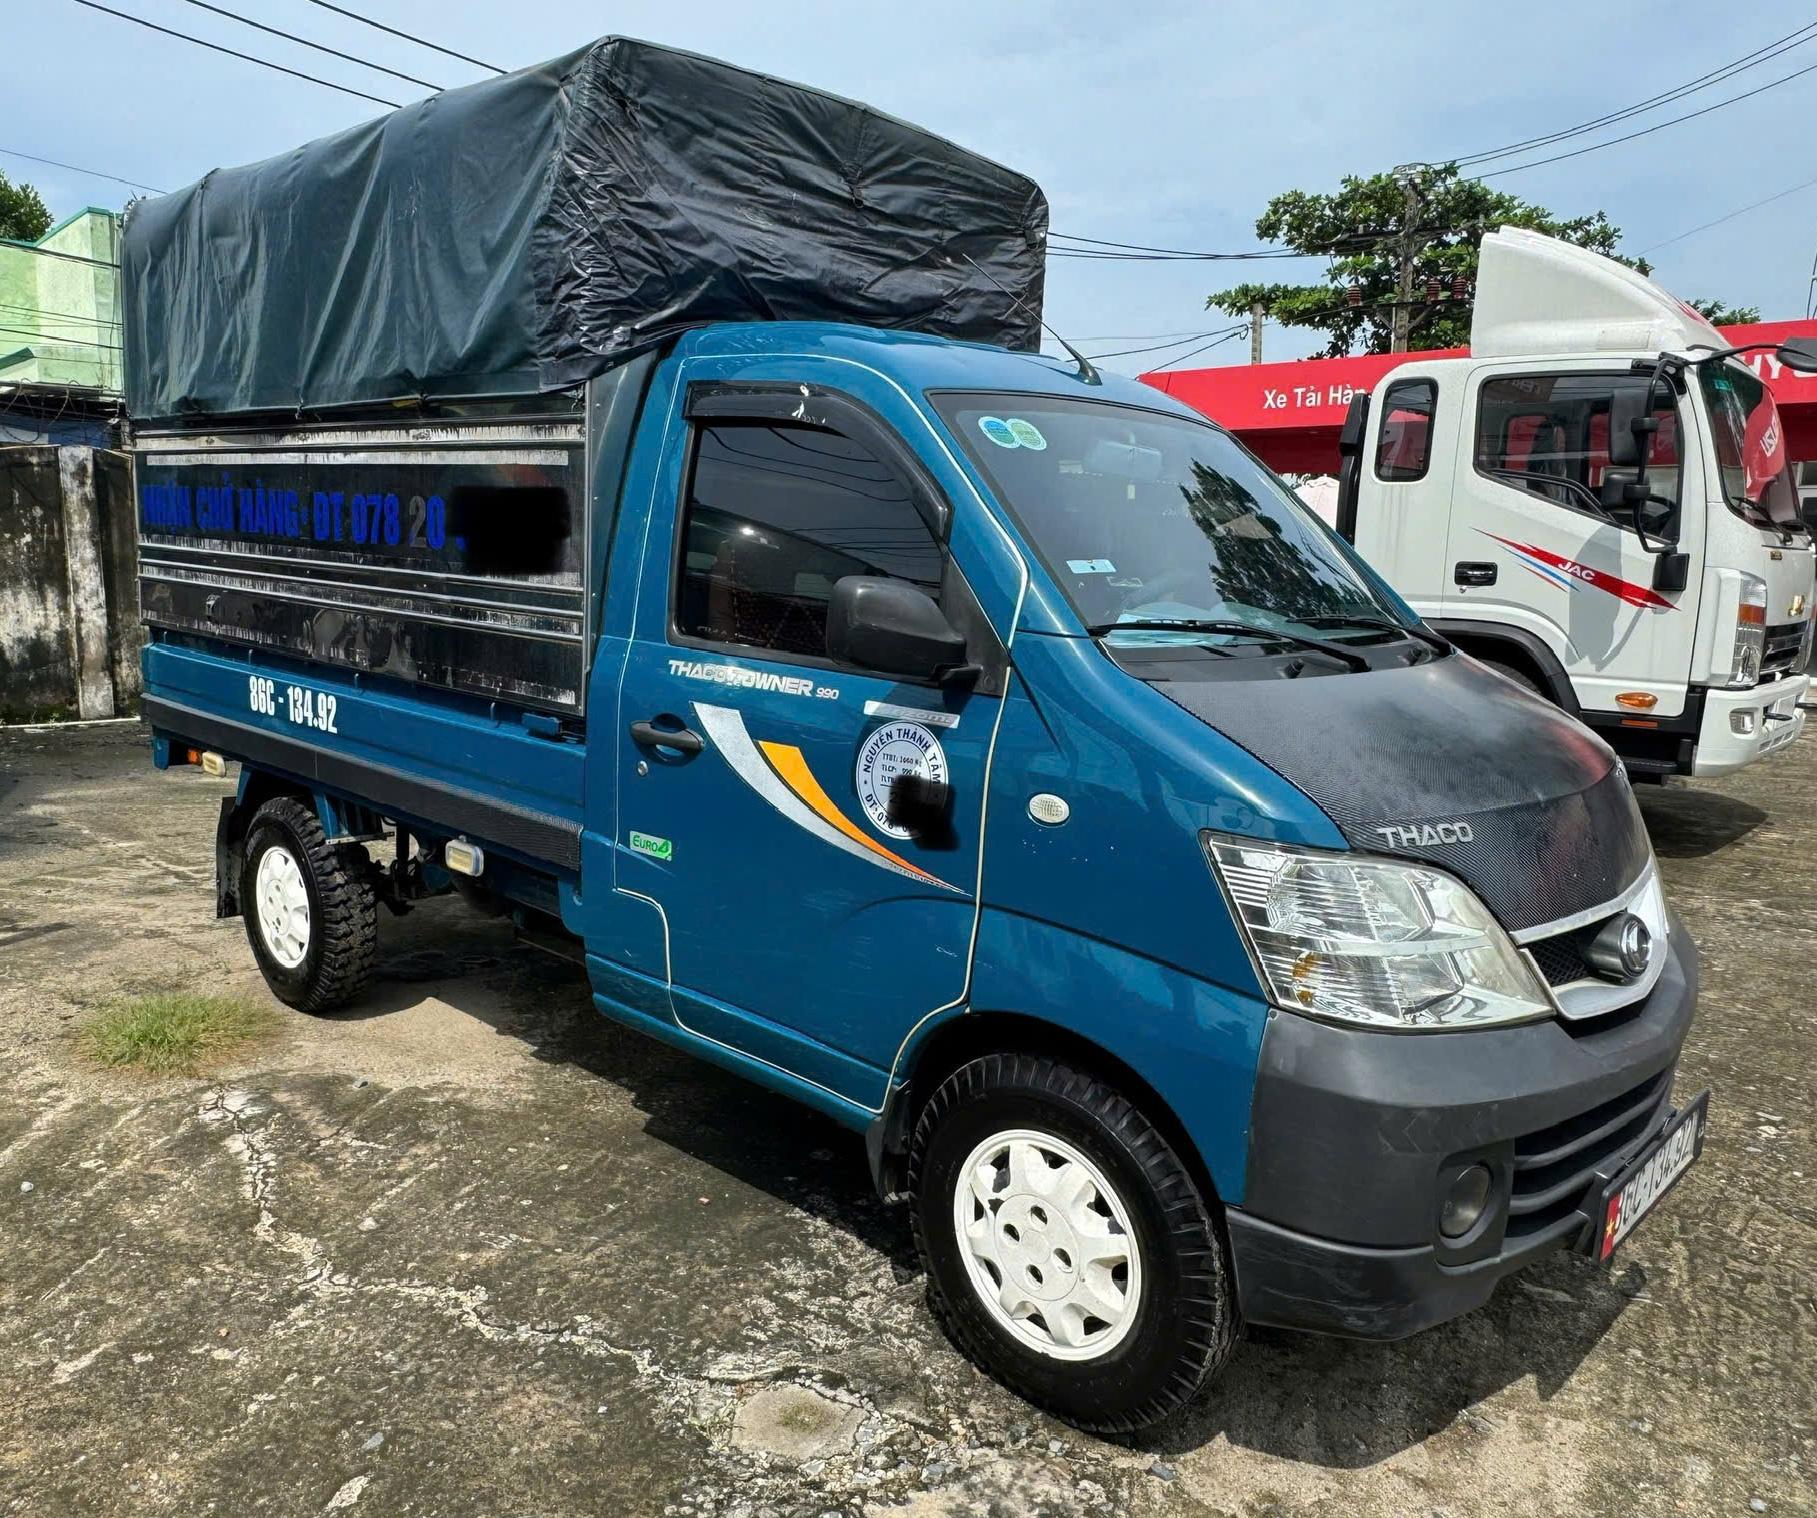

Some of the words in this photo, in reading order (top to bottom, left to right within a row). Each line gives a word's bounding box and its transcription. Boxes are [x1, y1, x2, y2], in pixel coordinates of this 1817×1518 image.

[1263, 389, 1288, 409] Xe
[1293, 385, 1321, 408] Tải
[351, 492, 401, 547] 078
[1558, 561, 1595, 580] JAC
[249, 675, 275, 716] 86C
[286, 685, 338, 734] 134.92
[815, 687, 840, 700] 990
[863, 729, 894, 773] NGUYỄN
[1375, 821, 1474, 849] THACO
